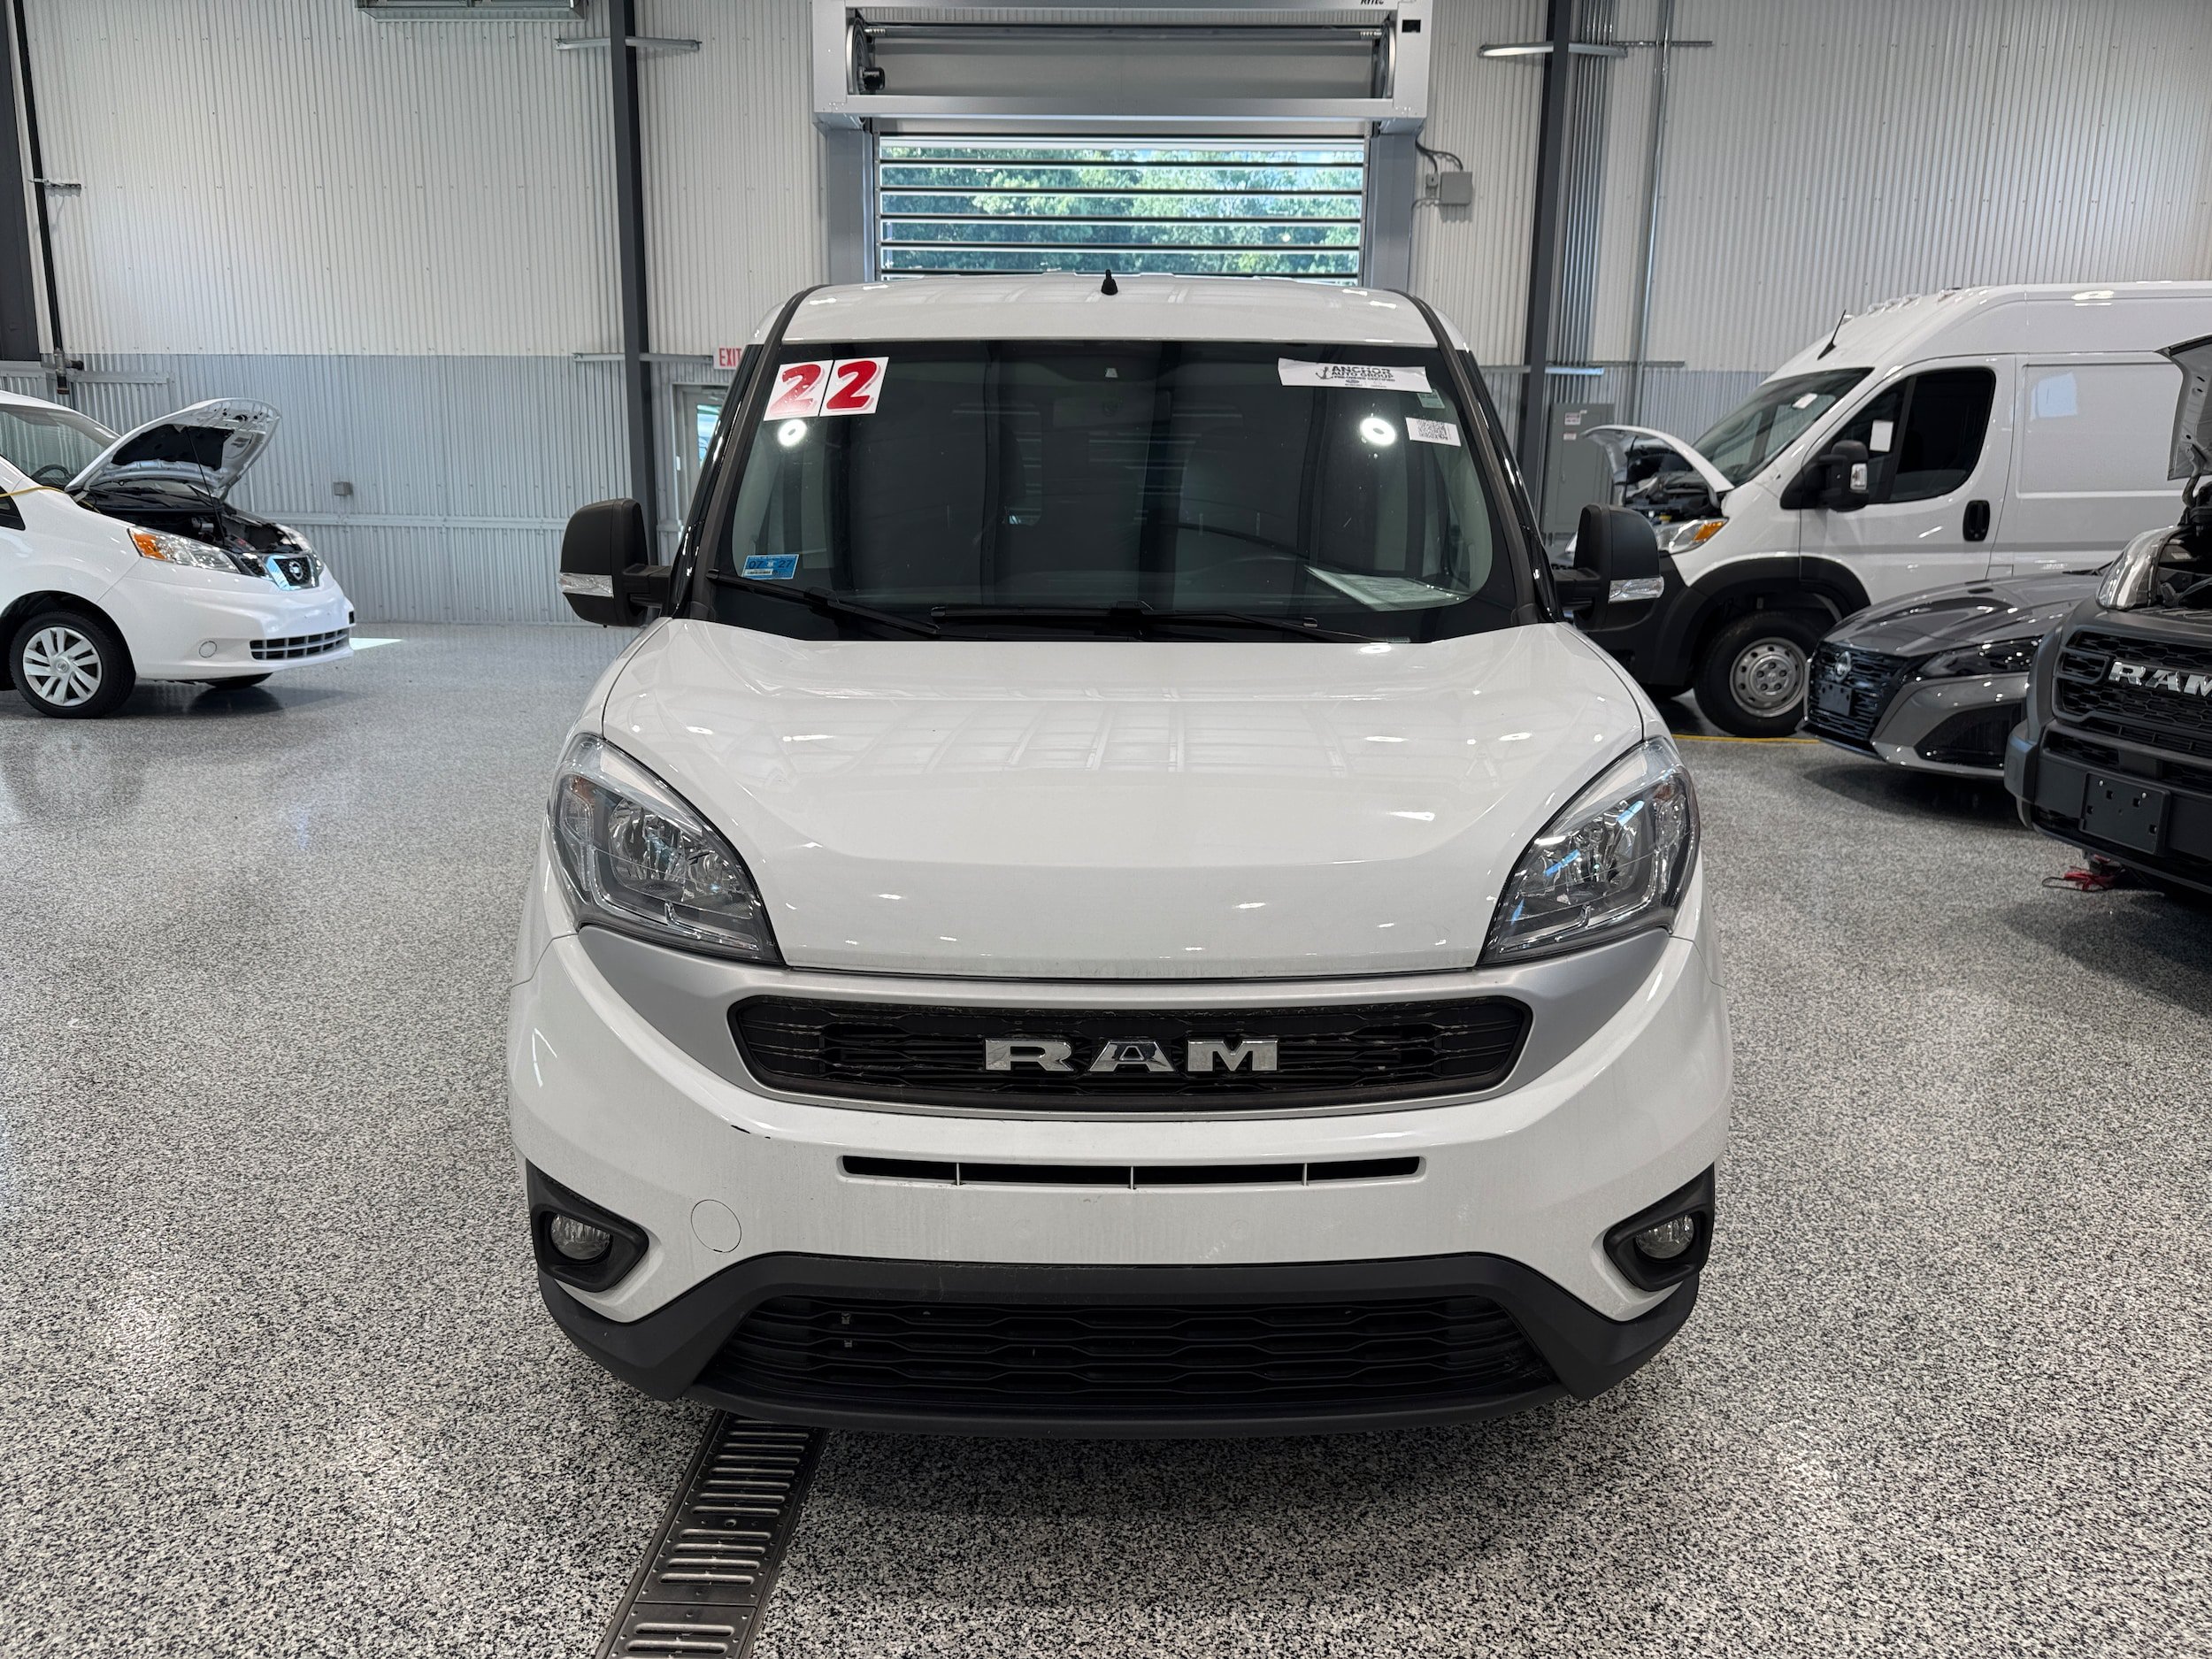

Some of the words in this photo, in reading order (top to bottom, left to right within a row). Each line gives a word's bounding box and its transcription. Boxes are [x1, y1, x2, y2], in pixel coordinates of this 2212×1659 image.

[718, 348, 742, 367] EXIT
[1332, 365, 1391, 375] ANCHOR
[770, 359, 879, 415] 22
[749, 560, 764, 569] 07
[779, 559, 794, 568] 27
[2108, 661, 2212, 697] RAM
[985, 1038, 1279, 1072] RAM
